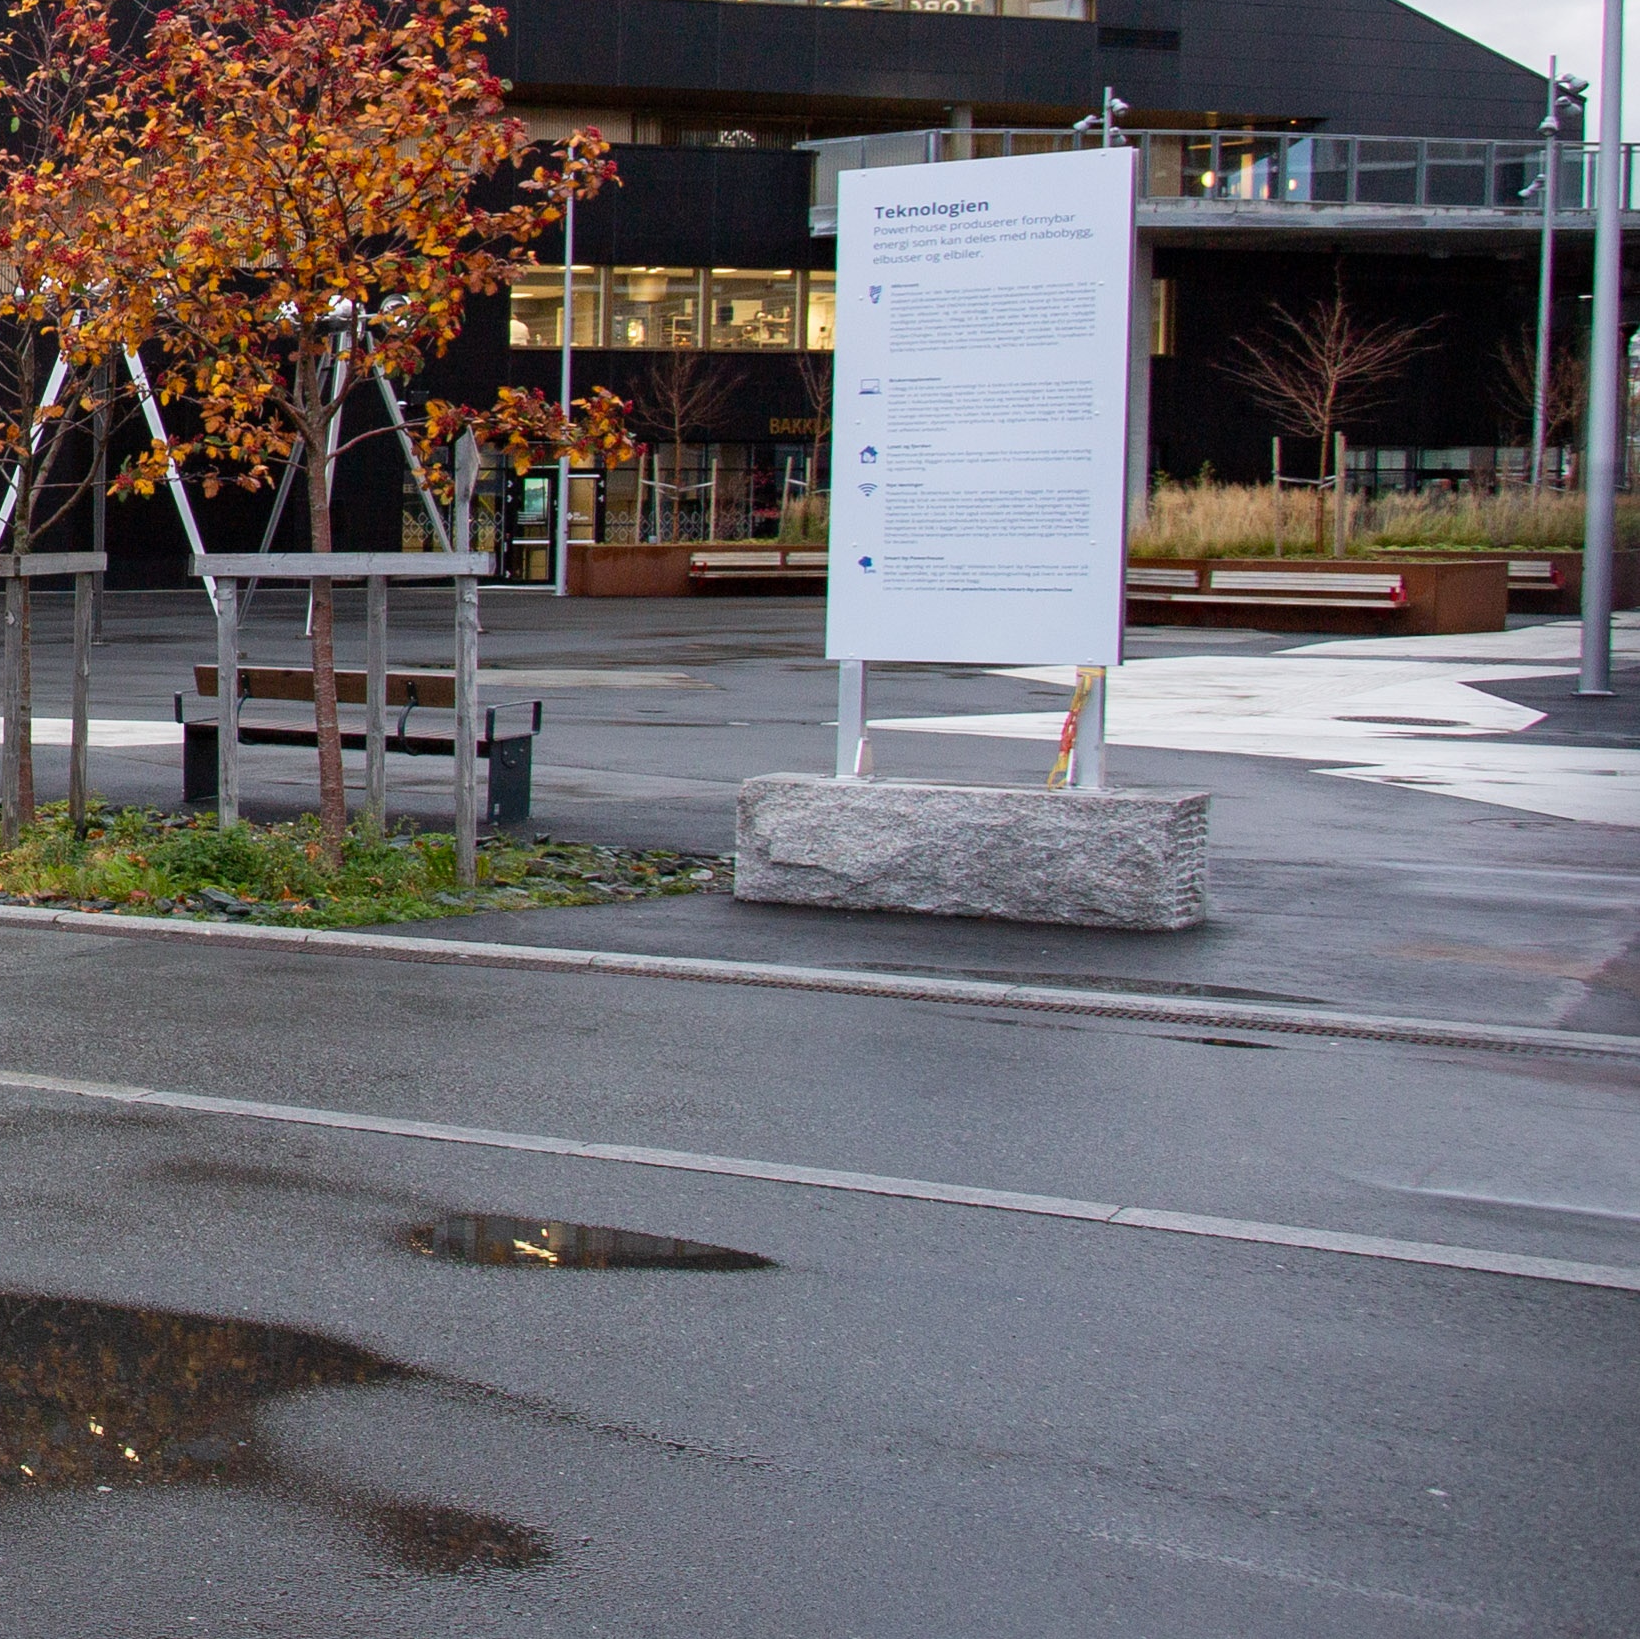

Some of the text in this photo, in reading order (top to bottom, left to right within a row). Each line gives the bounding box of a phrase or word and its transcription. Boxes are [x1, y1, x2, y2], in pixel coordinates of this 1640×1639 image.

[874, 200, 990, 220] Teknologien
[873, 213, 1076, 236] Powerhouse produserer fornybar
[873, 227, 1094, 251] energi som kan deles med nabobygg,
[873, 248, 984, 265] elbusser og elbiler.
